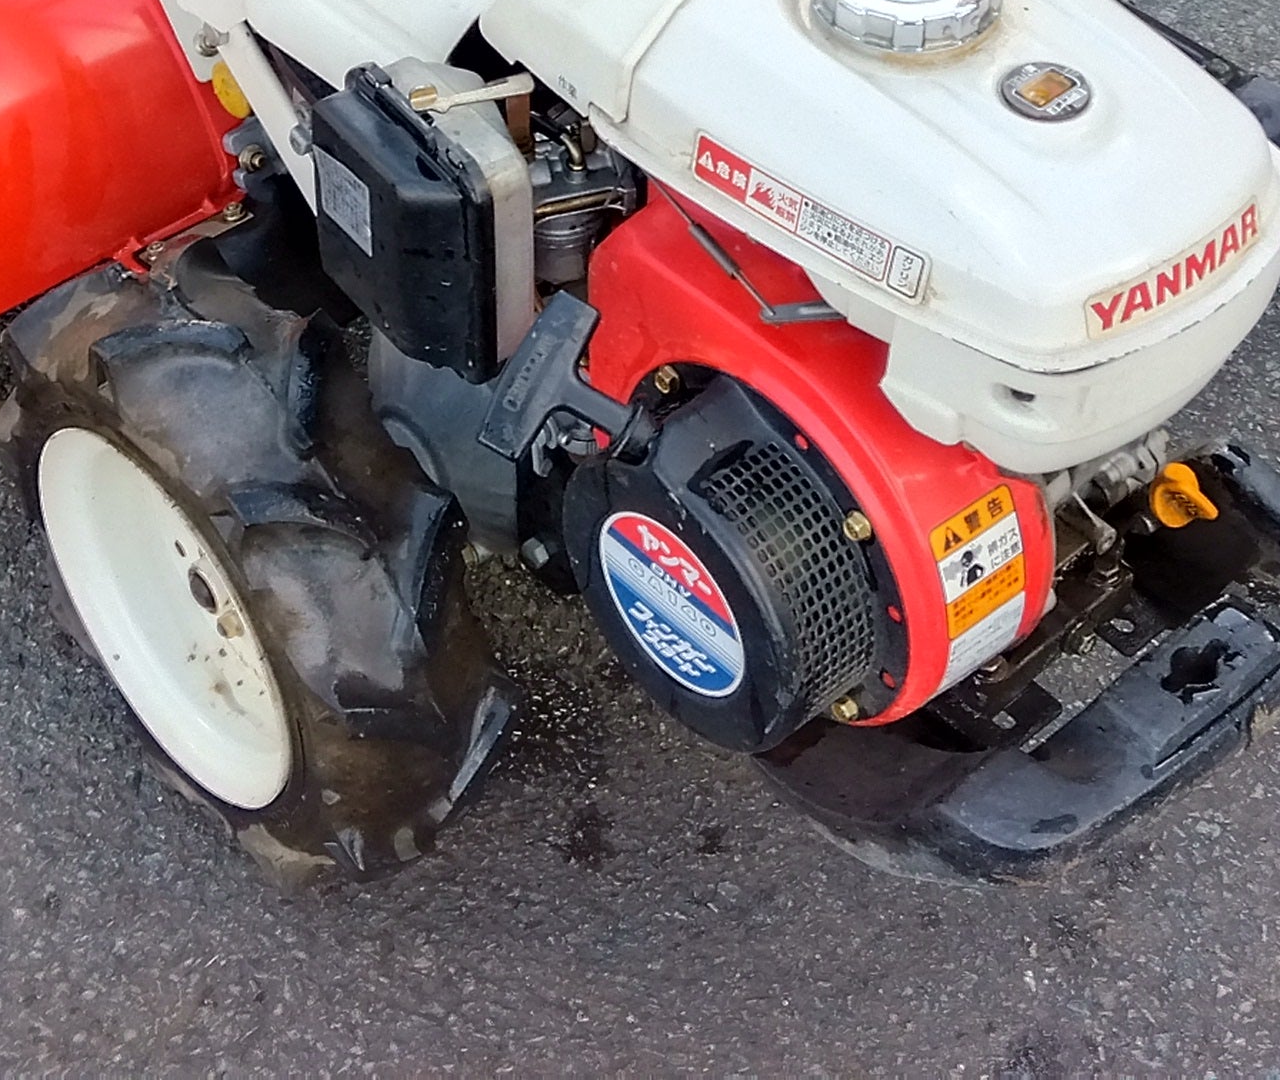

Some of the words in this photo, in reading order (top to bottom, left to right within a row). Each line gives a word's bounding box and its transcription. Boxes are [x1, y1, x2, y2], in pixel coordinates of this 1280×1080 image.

[716, 161, 747, 190] 危険
[778, 192, 800, 212] 火気
[1091, 203, 1258, 331] YANMAR
[964, 497, 1004, 534] 警告
[637, 525, 712, 596] ヤンマー
[649, 562, 692, 598] OHV
